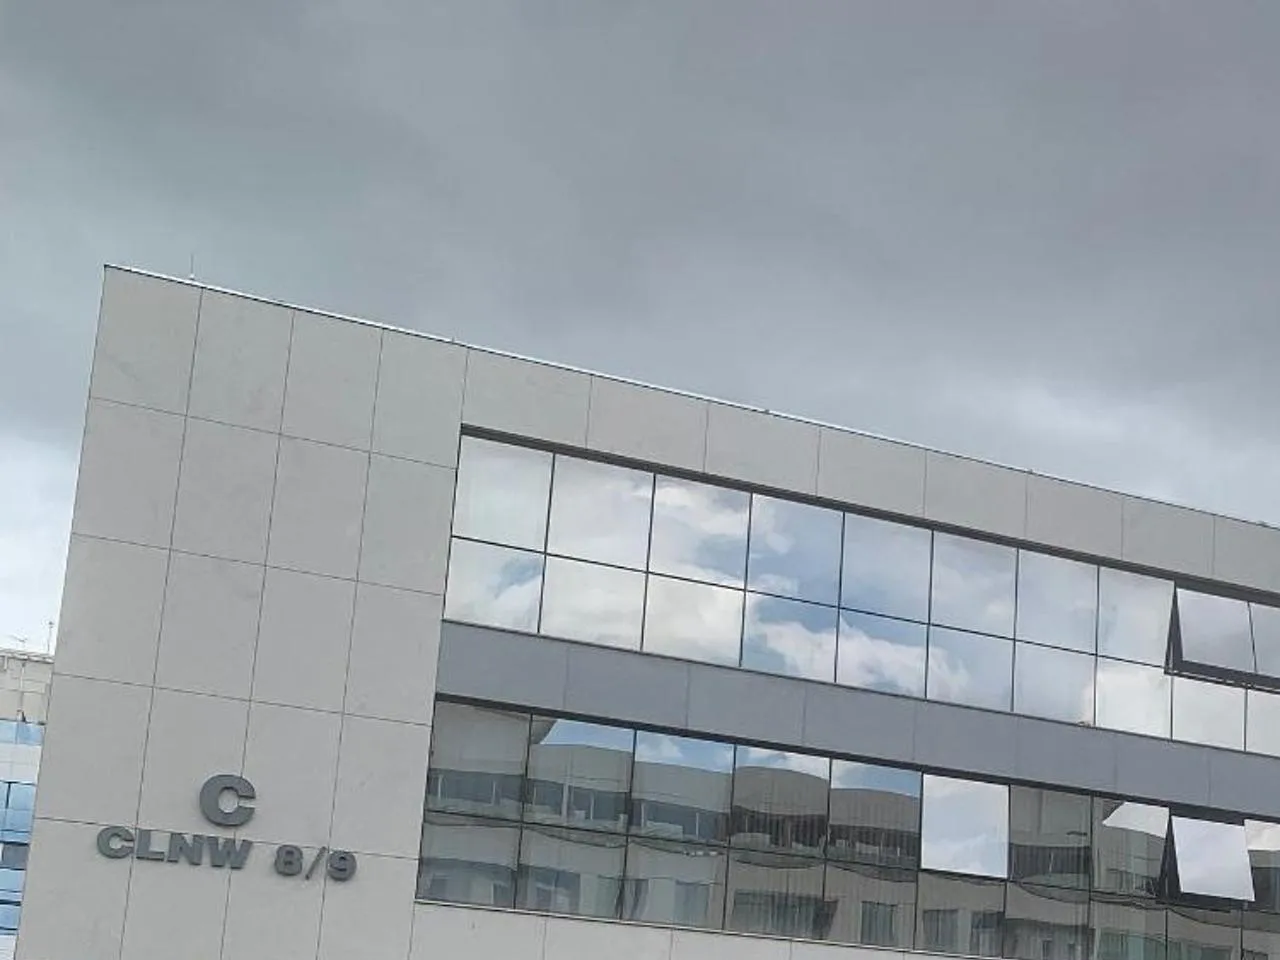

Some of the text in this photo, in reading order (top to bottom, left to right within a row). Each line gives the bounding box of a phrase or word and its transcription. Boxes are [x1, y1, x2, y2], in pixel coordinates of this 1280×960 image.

[199, 774, 257, 827] C
[96, 826, 358, 882] CLNW 8/9
